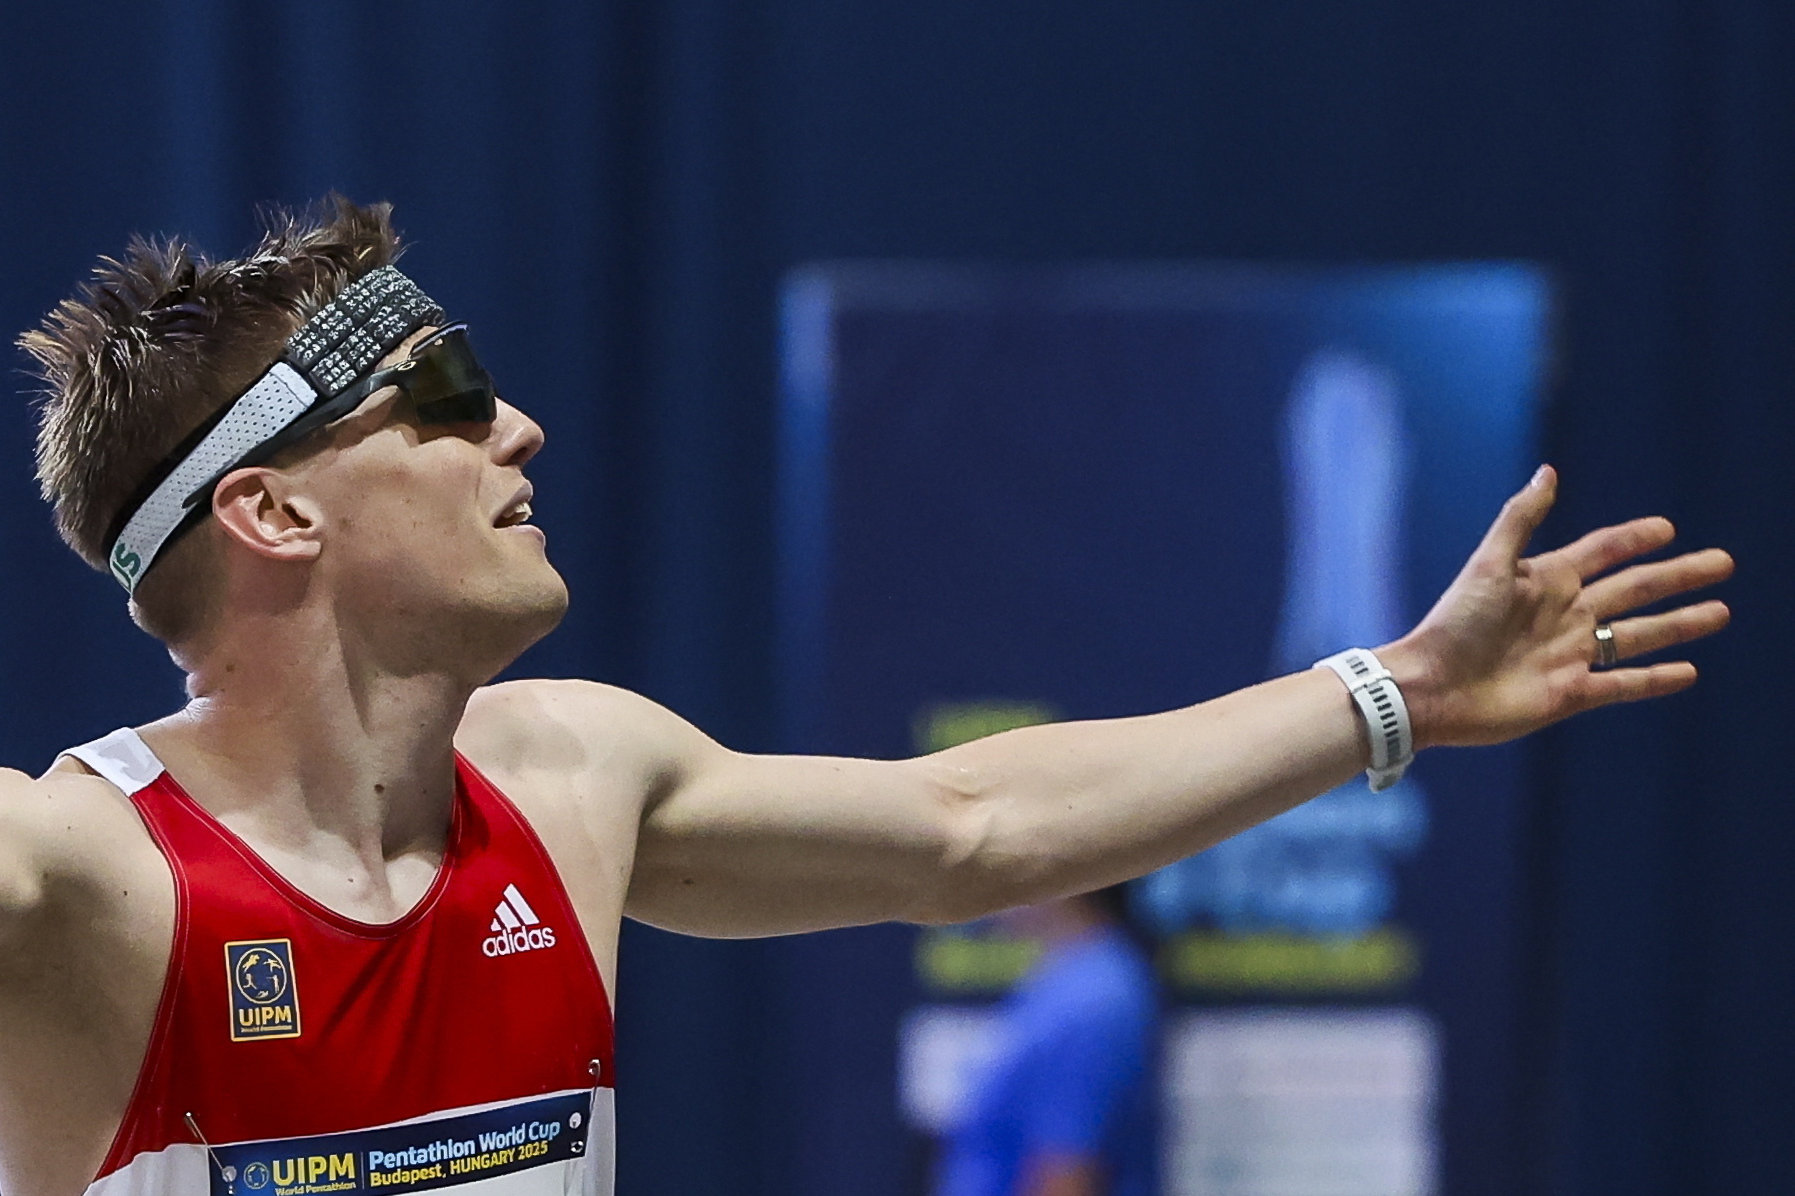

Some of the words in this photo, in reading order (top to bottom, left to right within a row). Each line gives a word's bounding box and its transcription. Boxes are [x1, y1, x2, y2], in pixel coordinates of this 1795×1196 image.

[482, 926, 556, 957] adidas
[239, 1005, 292, 1026] UIPM
[369, 1138, 476, 1170] Pentathlon
[479, 1123, 526, 1150] World
[528, 1121, 561, 1141] Cup
[272, 1152, 356, 1186] UIPM
[370, 1163, 447, 1187] Budapest,
[449, 1147, 515, 1175] HUNGARY
[518, 1140, 549, 1161] 2025
[275, 1185, 305, 1196] World
